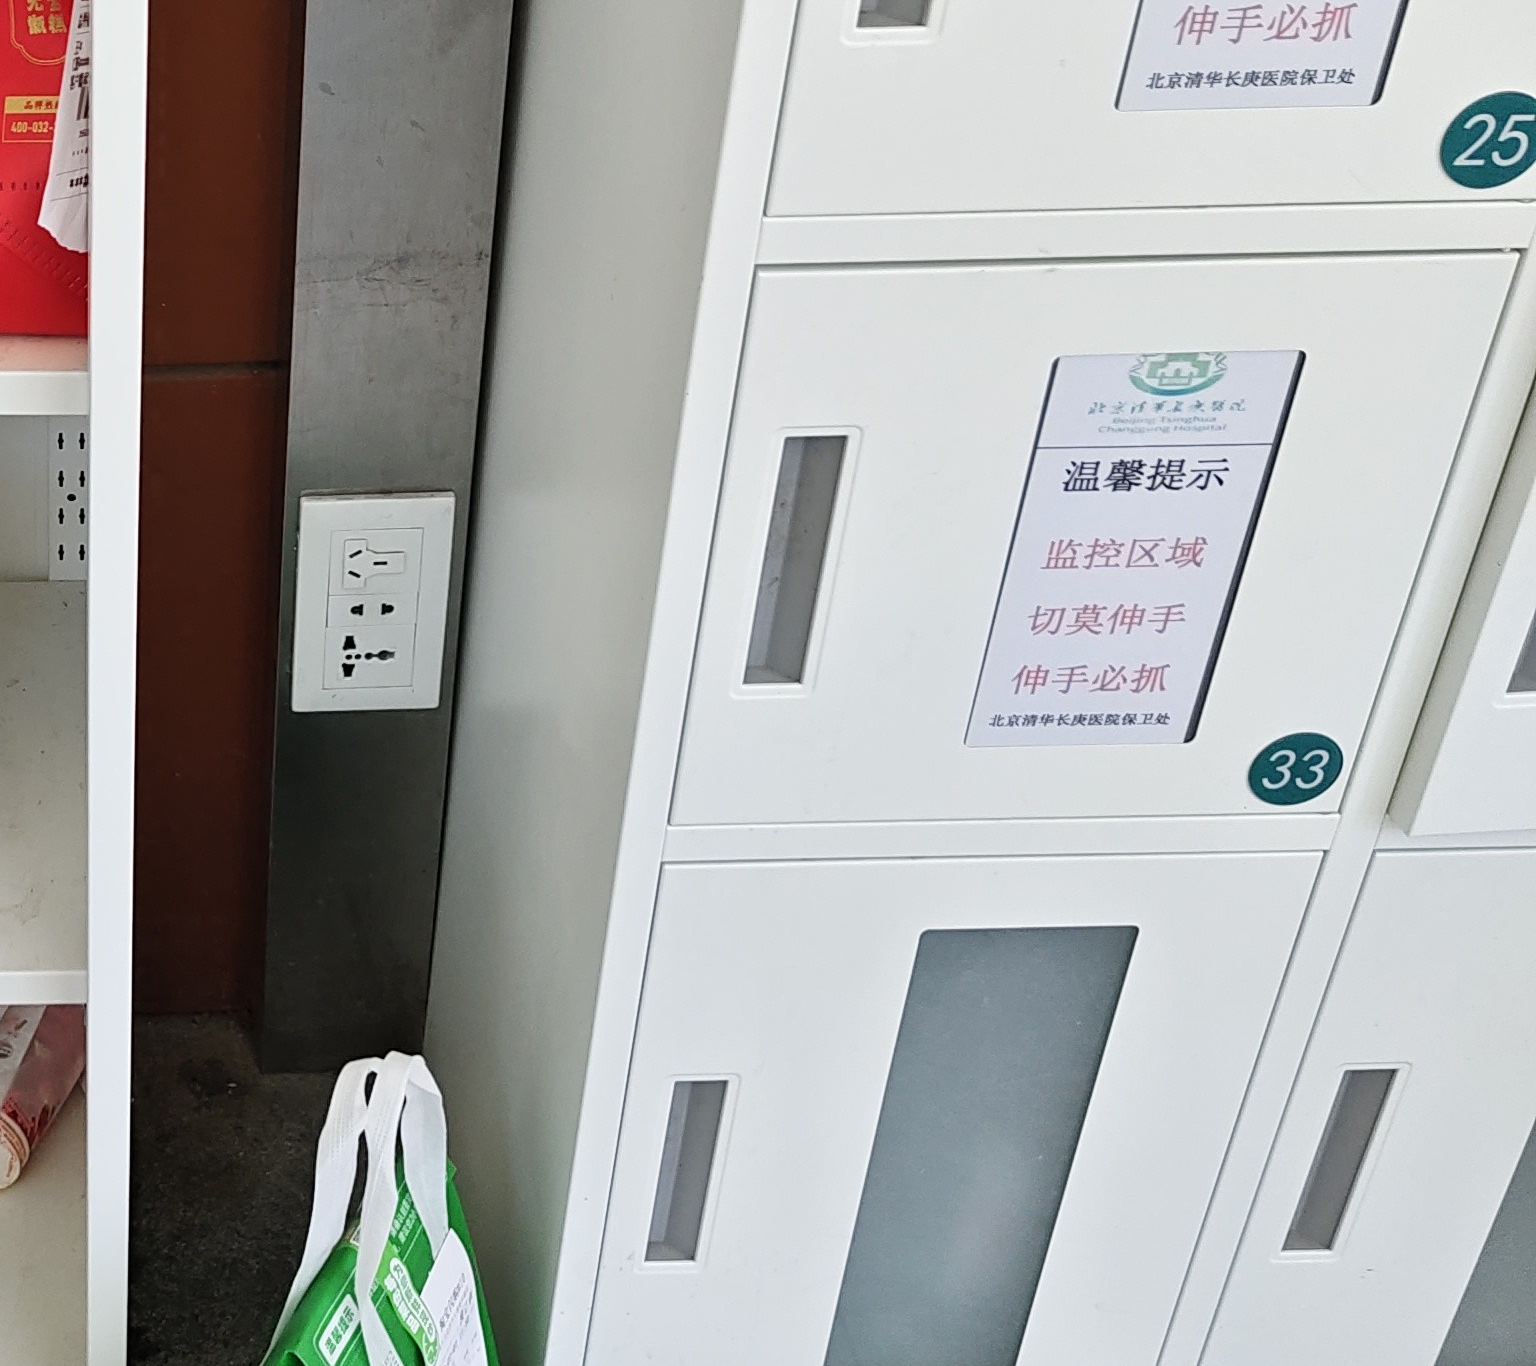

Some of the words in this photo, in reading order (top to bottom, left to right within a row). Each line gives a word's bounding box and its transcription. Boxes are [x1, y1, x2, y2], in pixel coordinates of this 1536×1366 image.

[1173, 3, 1358, 46] 伸手必抓
[1146, 68, 1356, 90] 北京清华长庚医院保卫处
[11, 122, 56, 133] 400-032-
[1454, 113, 1535, 167] 25
[1173, 423, 1227, 433] Hospital
[1062, 458, 1230, 492] 温馨提示
[1040, 536, 1208, 570] 监控区域
[1027, 603, 1186, 636] 切莫伸手
[1010, 663, 1171, 695] 伸手必抓
[988, 712, 1171, 727] 北京清华长庚医院保卫处
[1261, 750, 1330, 789] 33
